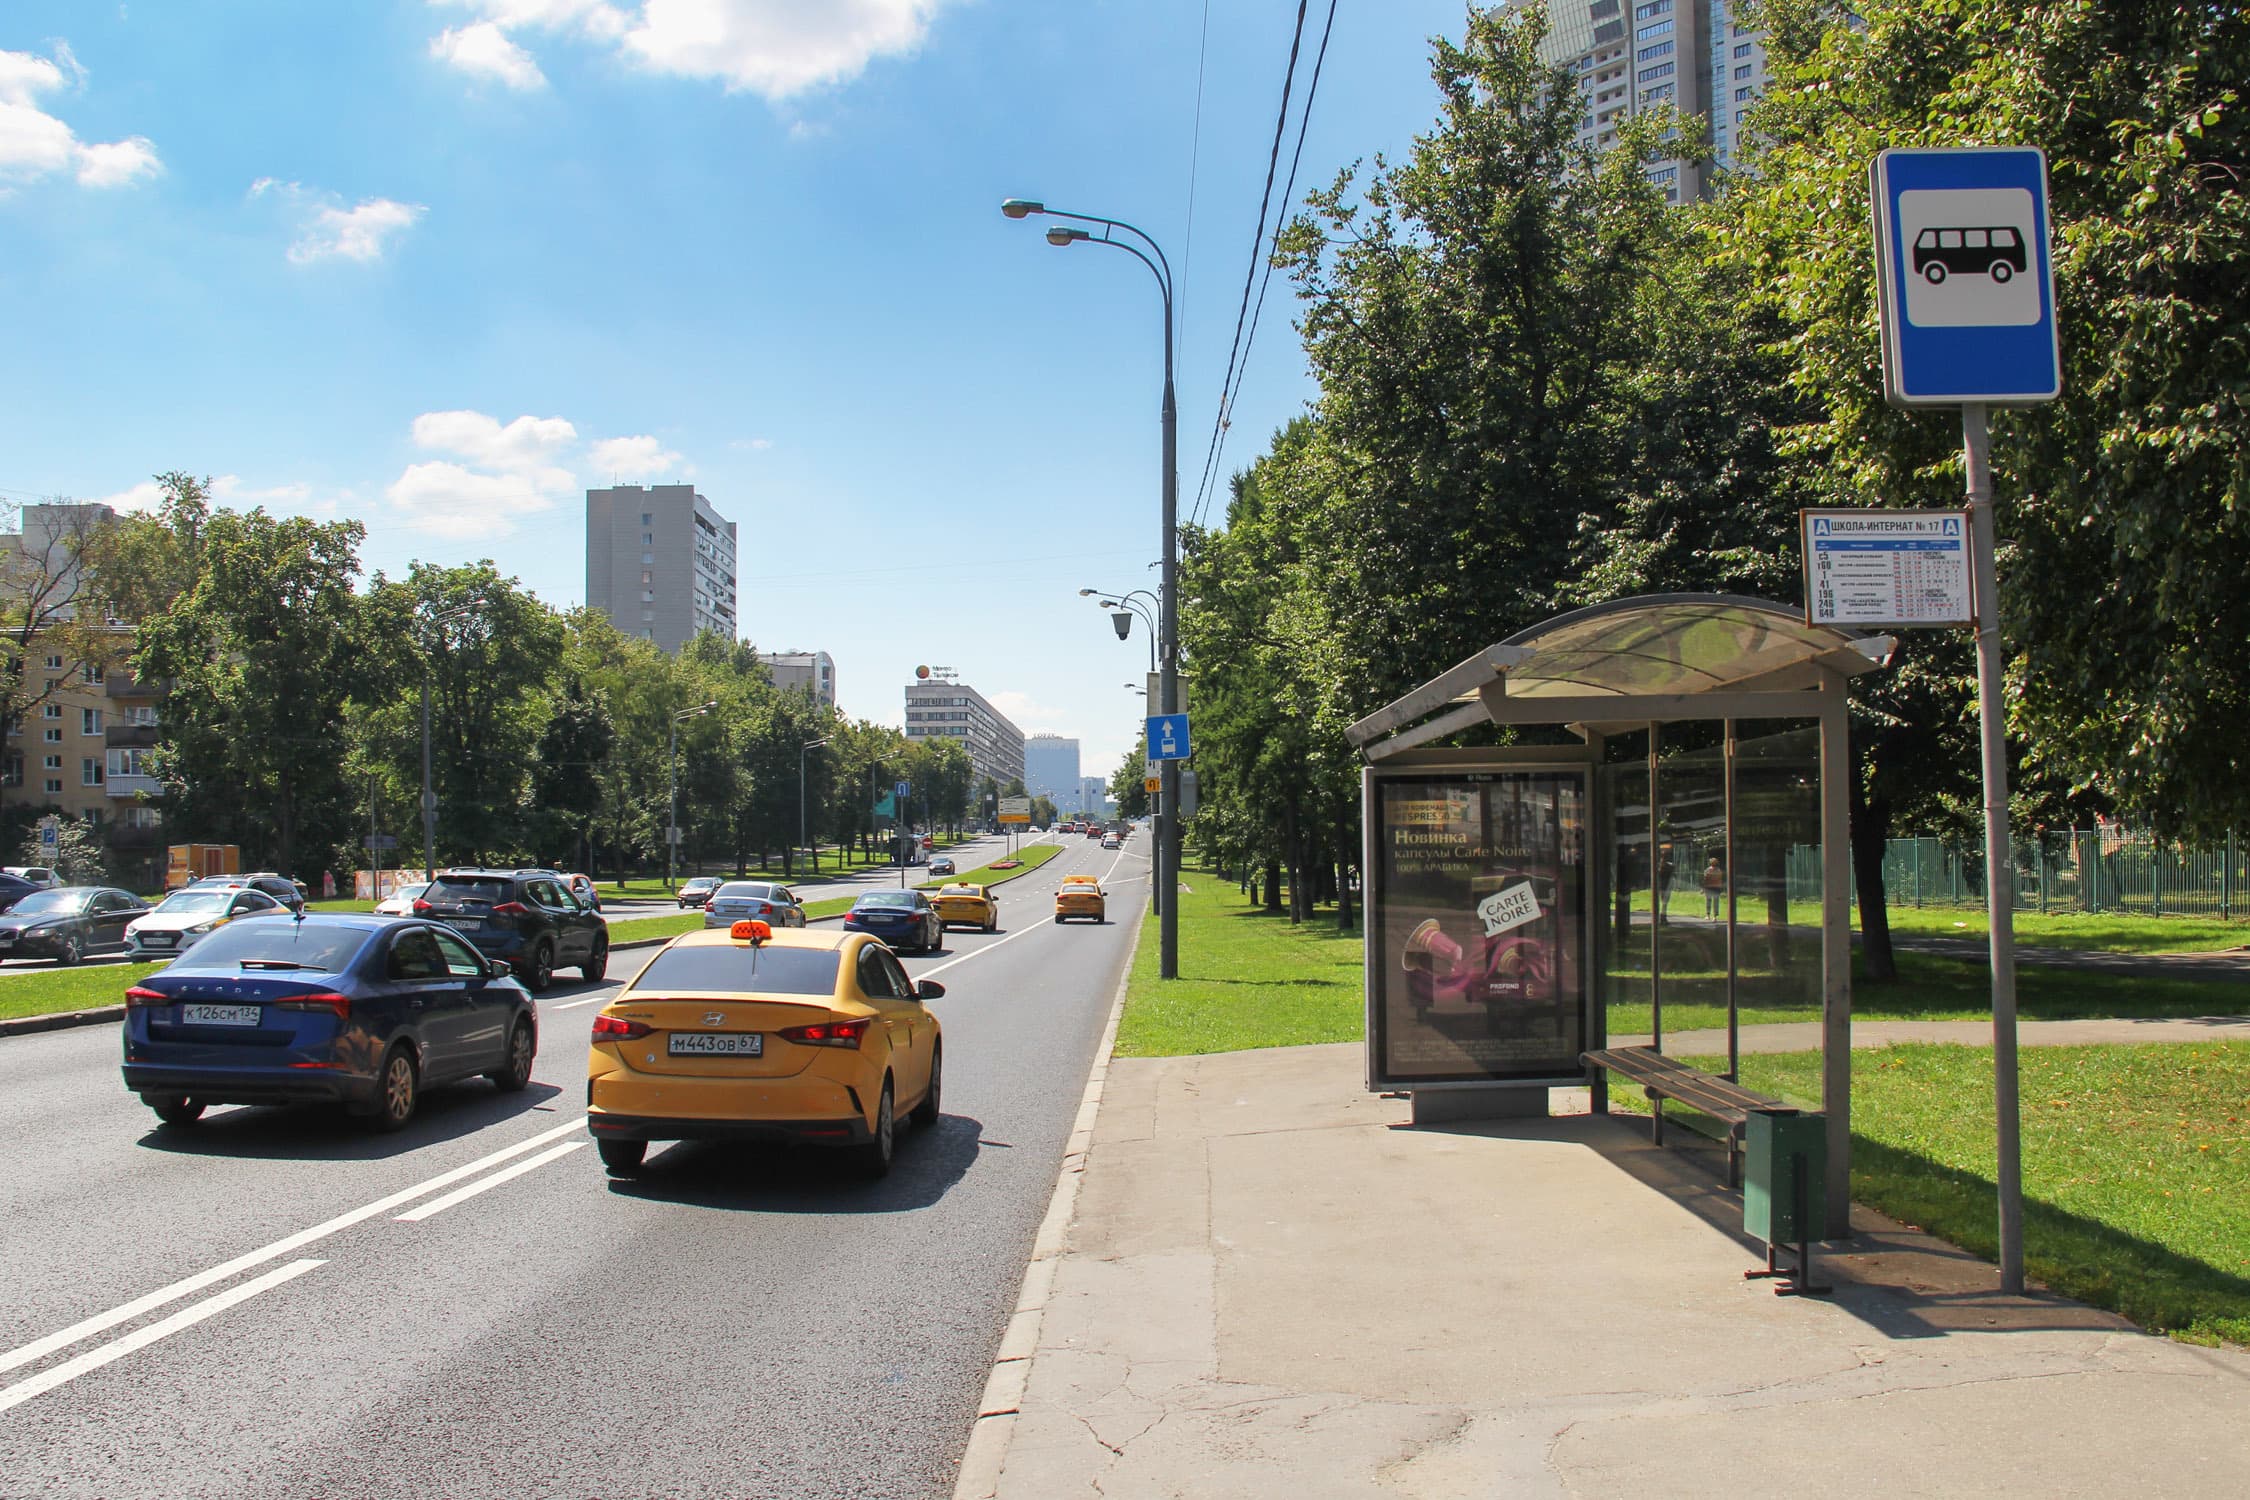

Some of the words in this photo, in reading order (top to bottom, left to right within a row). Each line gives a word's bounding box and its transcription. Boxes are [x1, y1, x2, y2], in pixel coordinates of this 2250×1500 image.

[1831, 521, 1912, 531] ШКОЛА-ИНТЕРНАТ
[1929, 521, 1940, 531] 17
[1395, 831, 1467, 845] Новинка
[1394, 848, 1450, 860] капсулы
[1454, 846, 1489, 857] Carte
[1494, 846, 1531, 857] Noire
[1486, 890, 1528, 916] CARTE
[1490, 902, 1533, 928] NOIRE
